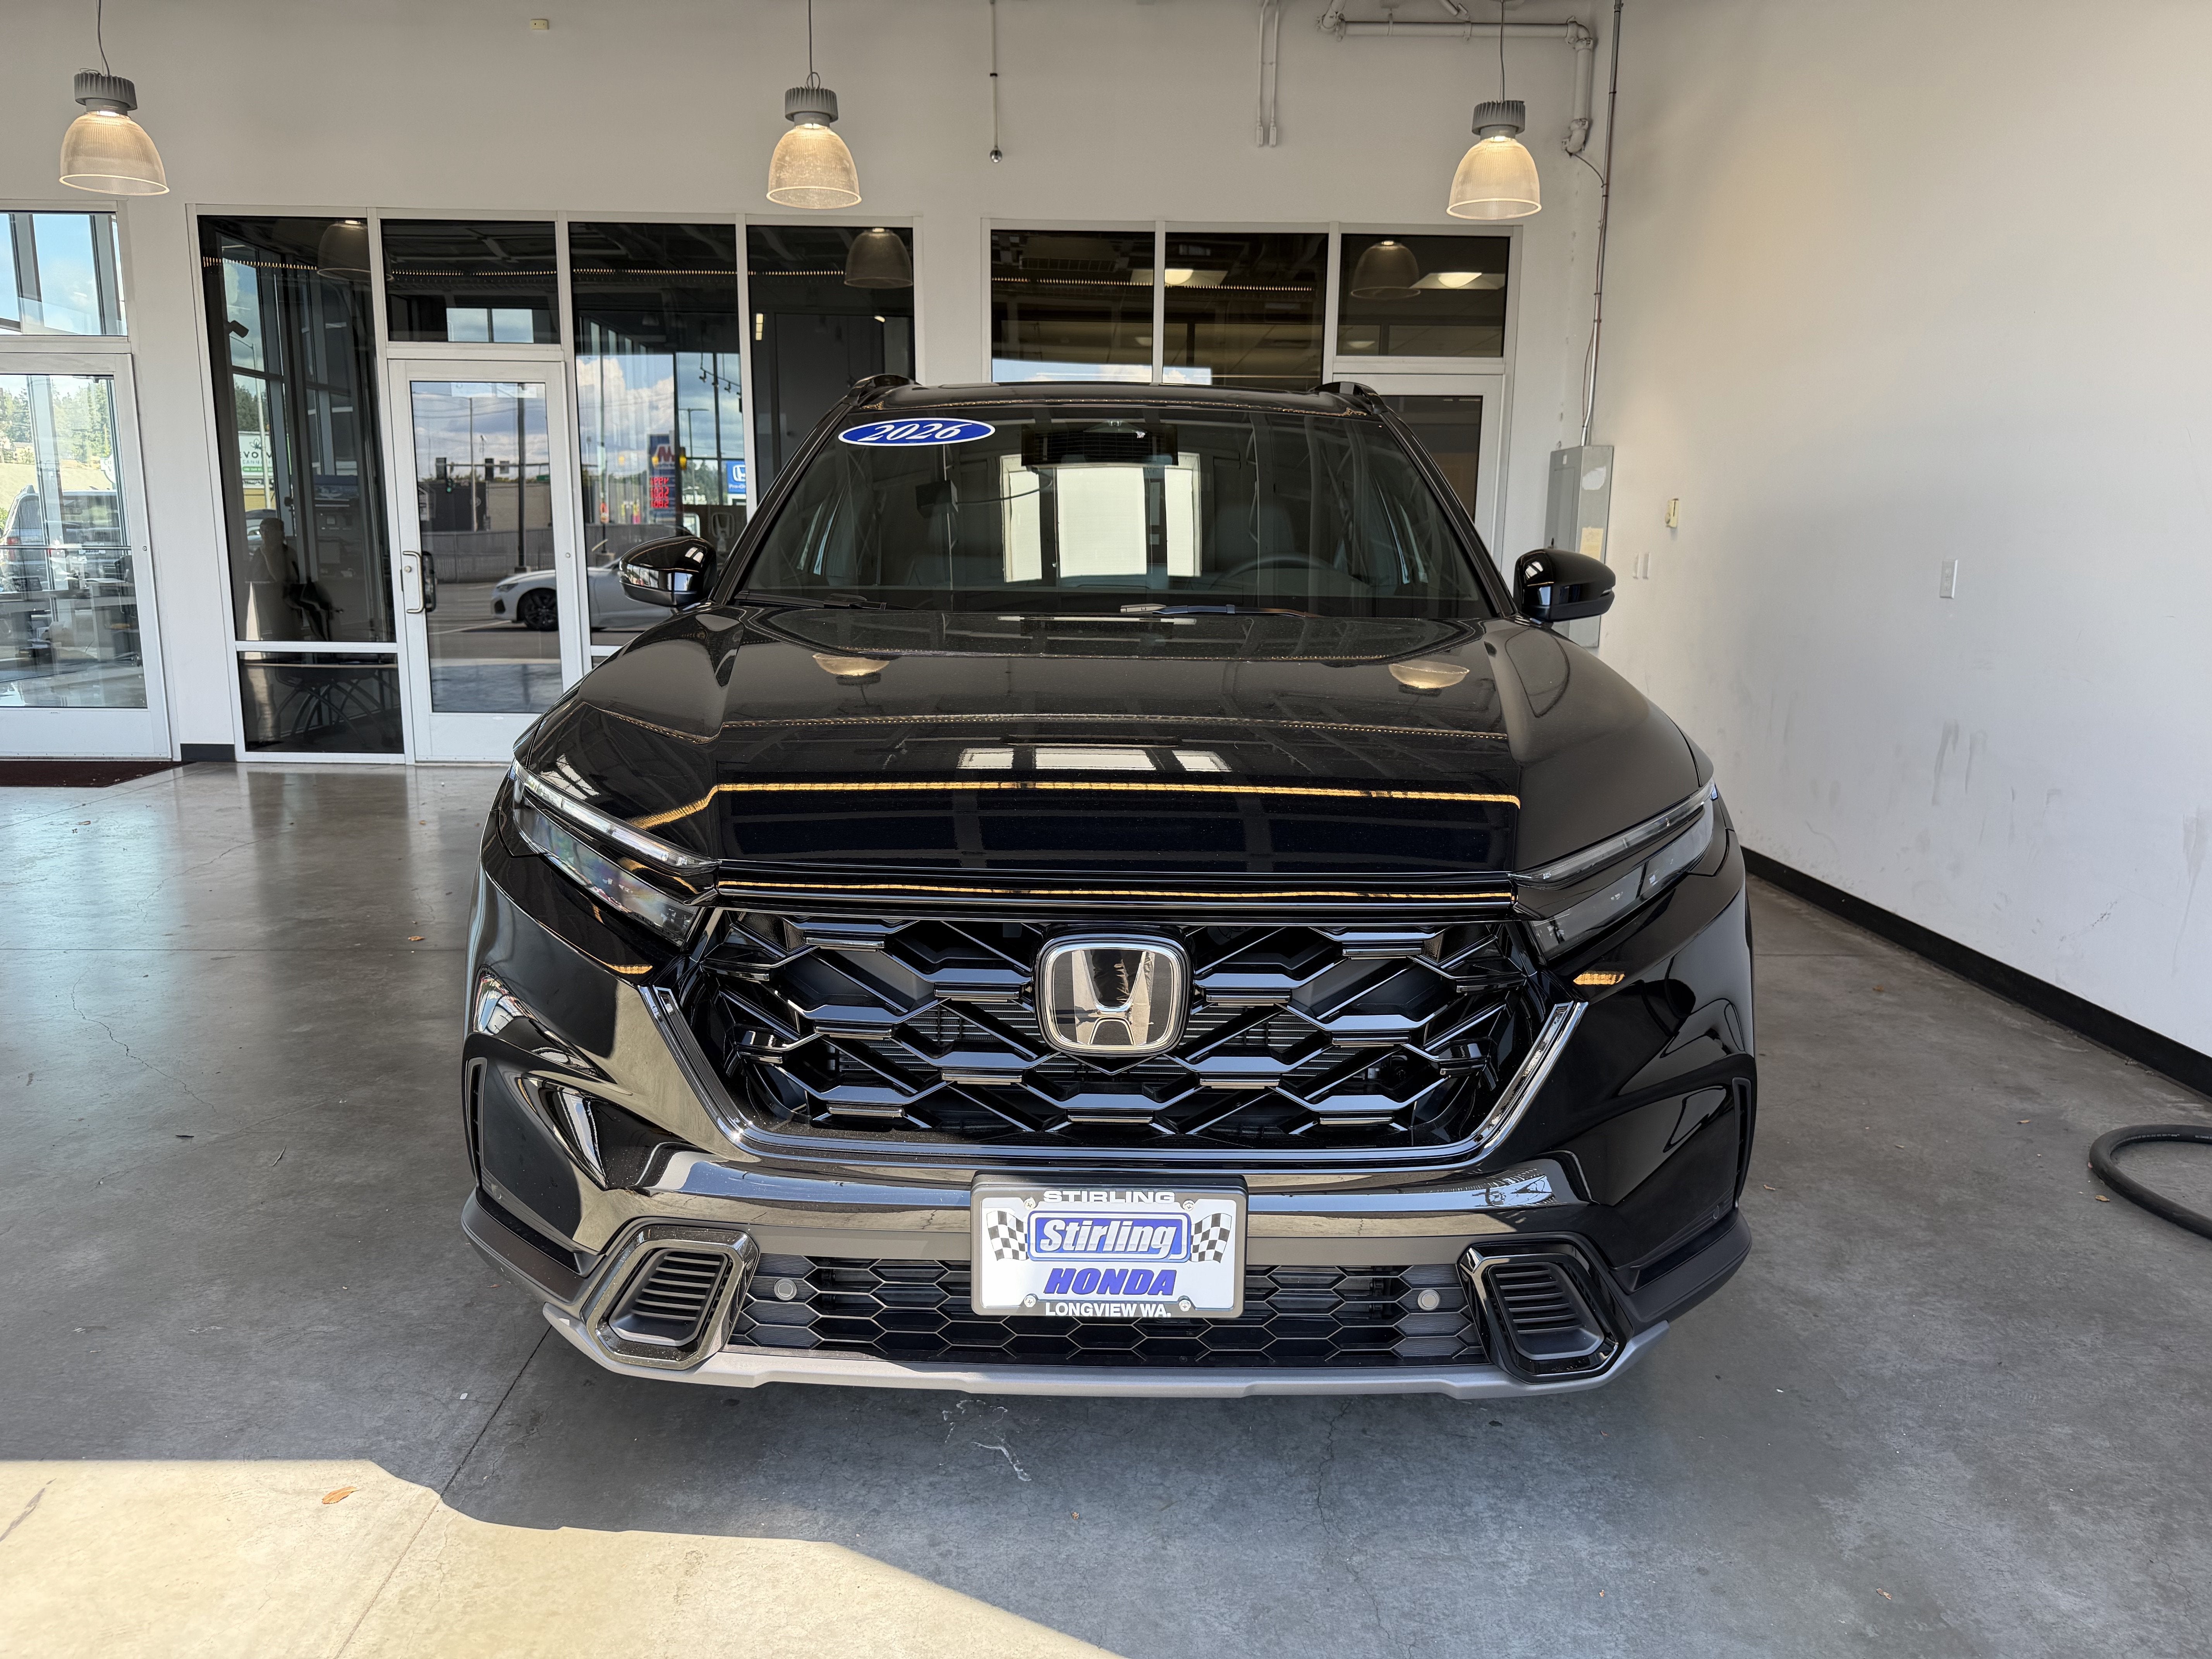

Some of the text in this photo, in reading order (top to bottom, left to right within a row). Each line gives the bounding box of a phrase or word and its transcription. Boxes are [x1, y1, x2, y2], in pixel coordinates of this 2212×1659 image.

[857, 423, 973, 441] 2026
[1043, 1191, 1175, 1204] STIRLING
[1040, 1219, 1177, 1259] Stirling
[1043, 1268, 1177, 1296] HONDA
[1045, 1302, 1171, 1317] LONGVIEW WA.
